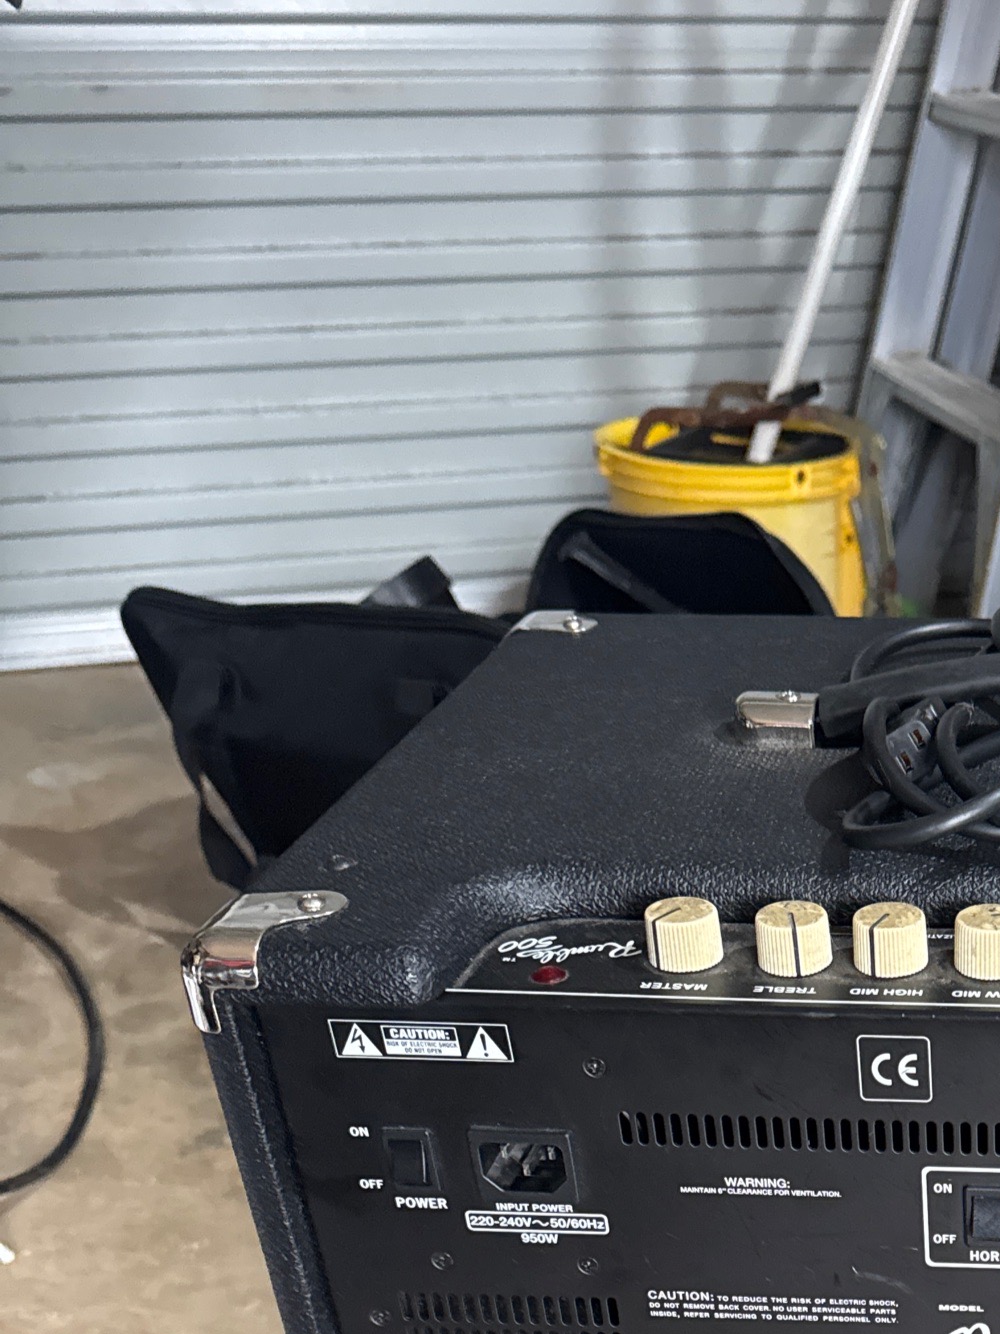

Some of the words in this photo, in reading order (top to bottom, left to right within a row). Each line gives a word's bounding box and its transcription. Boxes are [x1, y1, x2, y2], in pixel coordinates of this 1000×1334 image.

[498, 936, 557, 953] 500
[517, 940, 642, 963] Rumble
[640, 982, 708, 991] MASTER
[753, 985, 816, 994] TREBLE
[850, 987, 879, 996] MID
[883, 989, 923, 997] HIGH
[951, 990, 981, 998] MID
[389, 1028, 450, 1040] CAUTION:
[349, 1126, 369, 1137] ON
[359, 1179, 384, 1189] OFF
[724, 1177, 790, 1189] WARNING:
[933, 1183, 953, 1194] ON
[680, 1186, 717, 1194] MAINTAIN
[727, 1187, 773, 1196] CLEARANCE
[791, 1189, 842, 1198] VENTILATION.
[395, 1196, 448, 1210] POWER
[495, 1202, 529, 1212] INPUT
[531, 1203, 573, 1213] POWER
[521, 1233, 558, 1245] 950W
[933, 1234, 956, 1245] OFF
[647, 1290, 715, 1301] CAUTION:
[732, 1295, 768, 1303] REDUCE
[770, 1296, 788, 1304] THE
[829, 1298, 867, 1306] ELECTRIC
[869, 1299, 899, 1307] SHOCK,
[742, 1304, 771, 1312] COVER.
[786, 1305, 808, 1313] USER
[811, 1306, 866, 1314] SERVICEABLE
[938, 1304, 984, 1313] MODEL
[650, 1310, 681, 1318] INSIDE,
[683, 1311, 710, 1319] REFER
[714, 1312, 757, 1320] SERVICING
[822, 1315, 871, 1323] PERSONNEL
